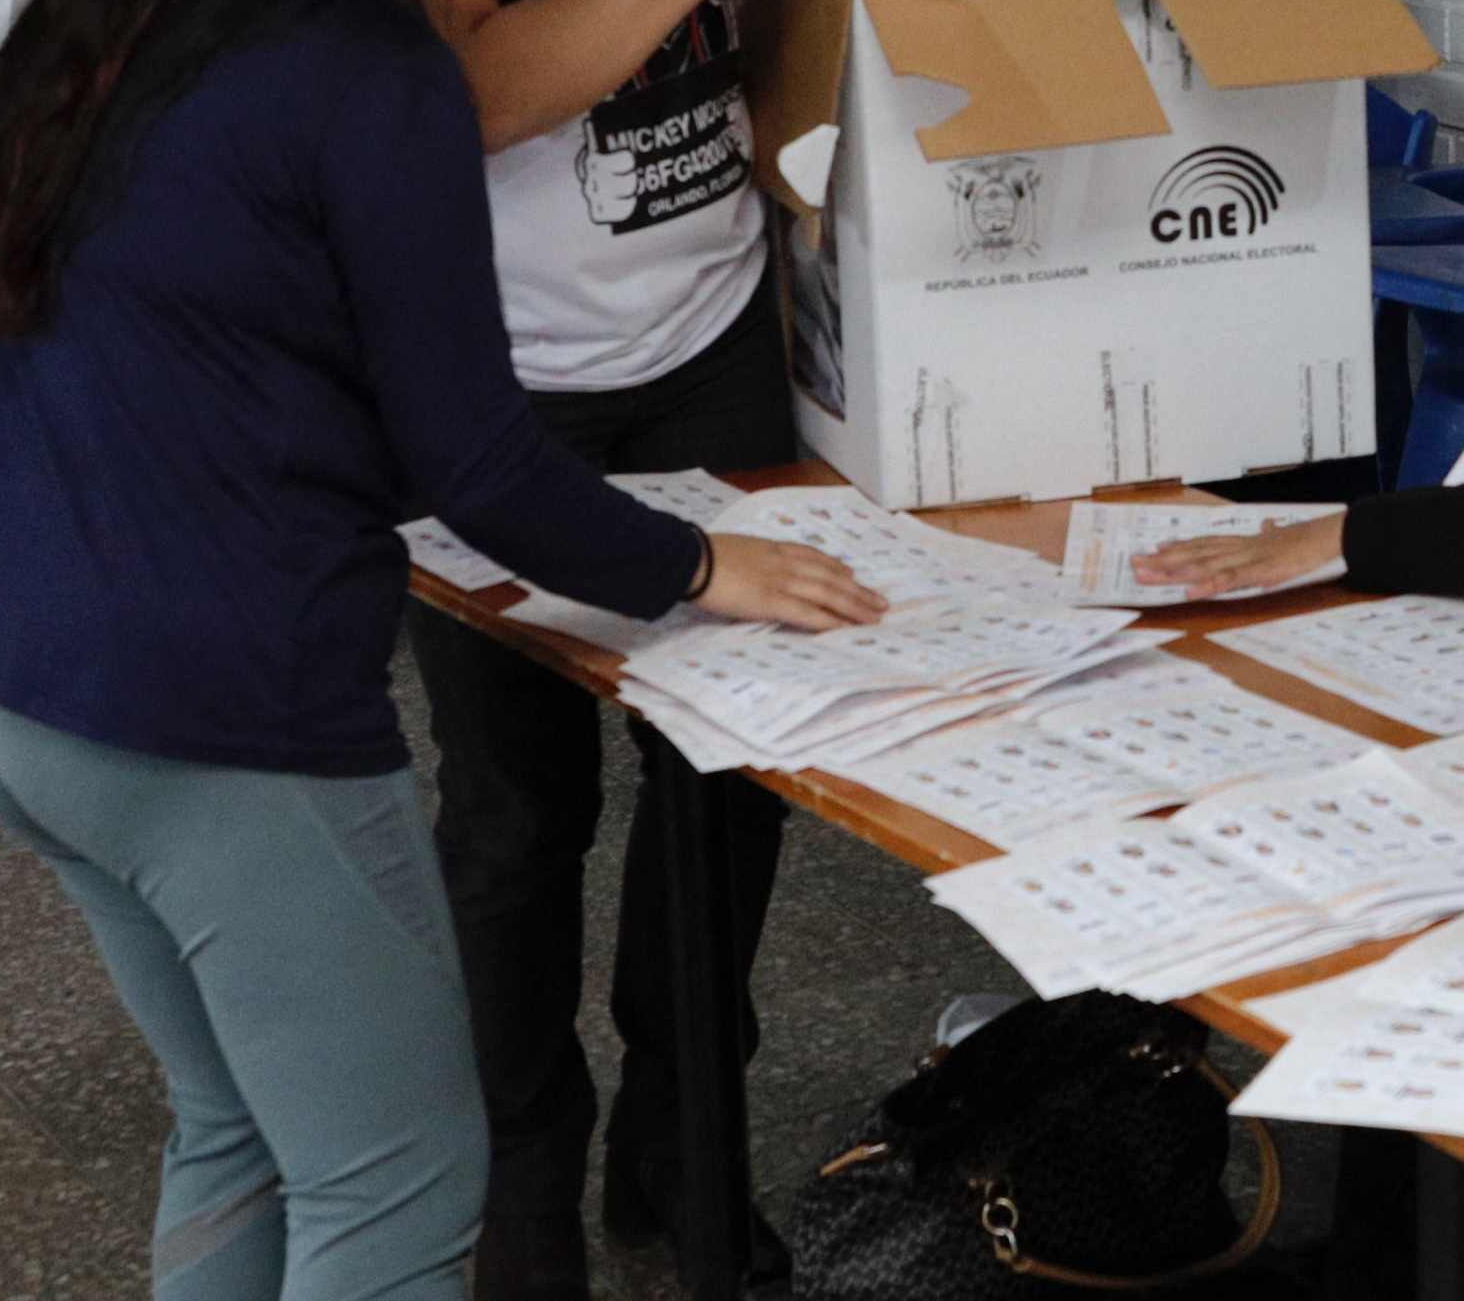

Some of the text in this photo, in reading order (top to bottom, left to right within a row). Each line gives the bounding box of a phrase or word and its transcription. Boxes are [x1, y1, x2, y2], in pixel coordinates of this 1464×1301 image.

[605, 112, 691, 153] MICKEY
[1119, 243, 1318, 273] CONSEJO NACIONAL ELECTORAL
[999, 272, 1024, 286] DEL
[1027, 266, 1089, 284] ECUADOR
